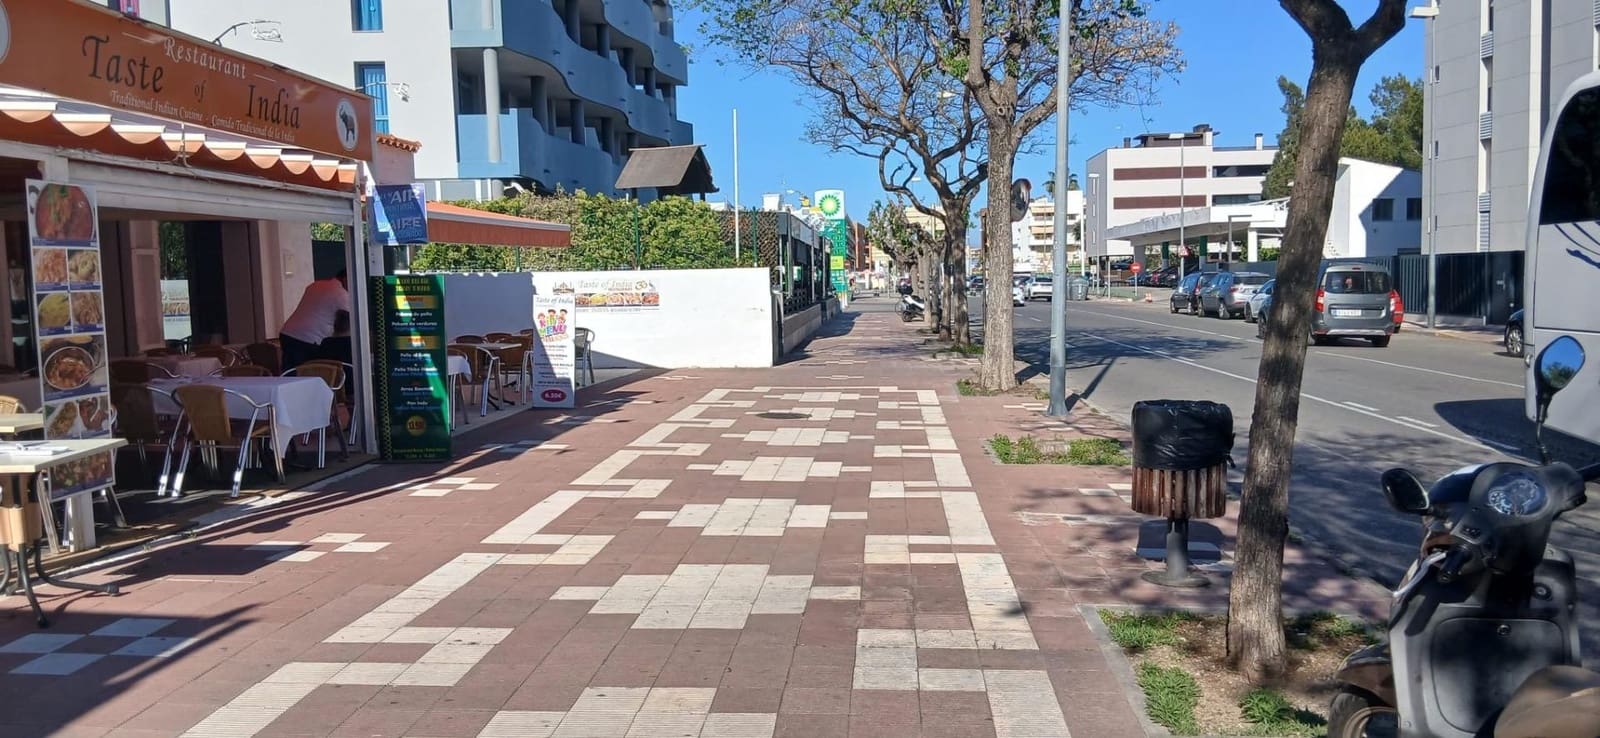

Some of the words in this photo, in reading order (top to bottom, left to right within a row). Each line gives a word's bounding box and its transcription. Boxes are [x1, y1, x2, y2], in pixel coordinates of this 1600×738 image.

[164, 36, 246, 79] Restaurant
[82, 34, 164, 93] Taste
[194, 79, 207, 102] of
[246, 84, 299, 129] India
[110, 90, 153, 110] Traditional
[154, 98, 179, 116] Indian
[211, 114, 235, 129] Comida
